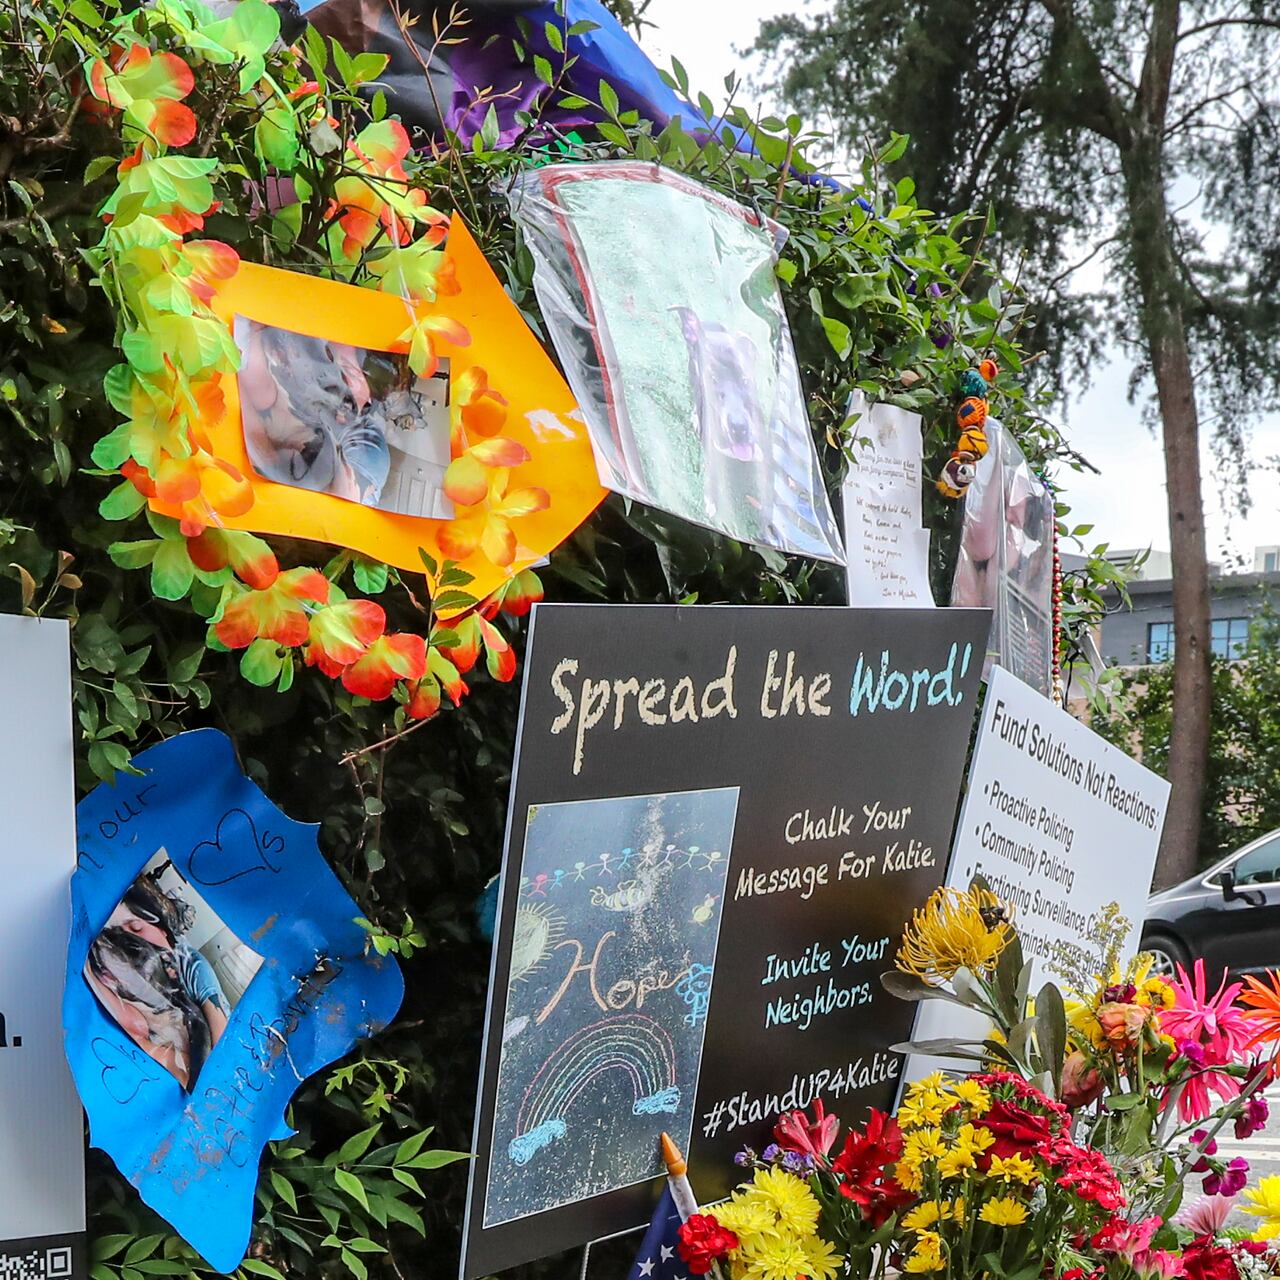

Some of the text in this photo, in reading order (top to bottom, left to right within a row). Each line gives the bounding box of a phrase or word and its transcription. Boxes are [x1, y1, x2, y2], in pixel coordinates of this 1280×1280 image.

[550, 643, 738, 775] Spread
[760, 648, 831, 718] the
[849, 642, 972, 718] Word!
[991, 700, 1160, 831] Fund Solutions Not Reactions:
[784, 801, 912, 845] Chalk Your
[989, 780, 1074, 853] Proactive Policing
[735, 839, 936, 900] Message For Katie.
[981, 822, 1075, 894] Community Policing
[1032, 889, 1086, 933] Surveillance
[536, 931, 690, 1026] Hope
[761, 934, 890, 985] Invite Your
[765, 978, 873, 1031] Neighbors.
[703, 1053, 899, 1138] #StandUP4Katie
